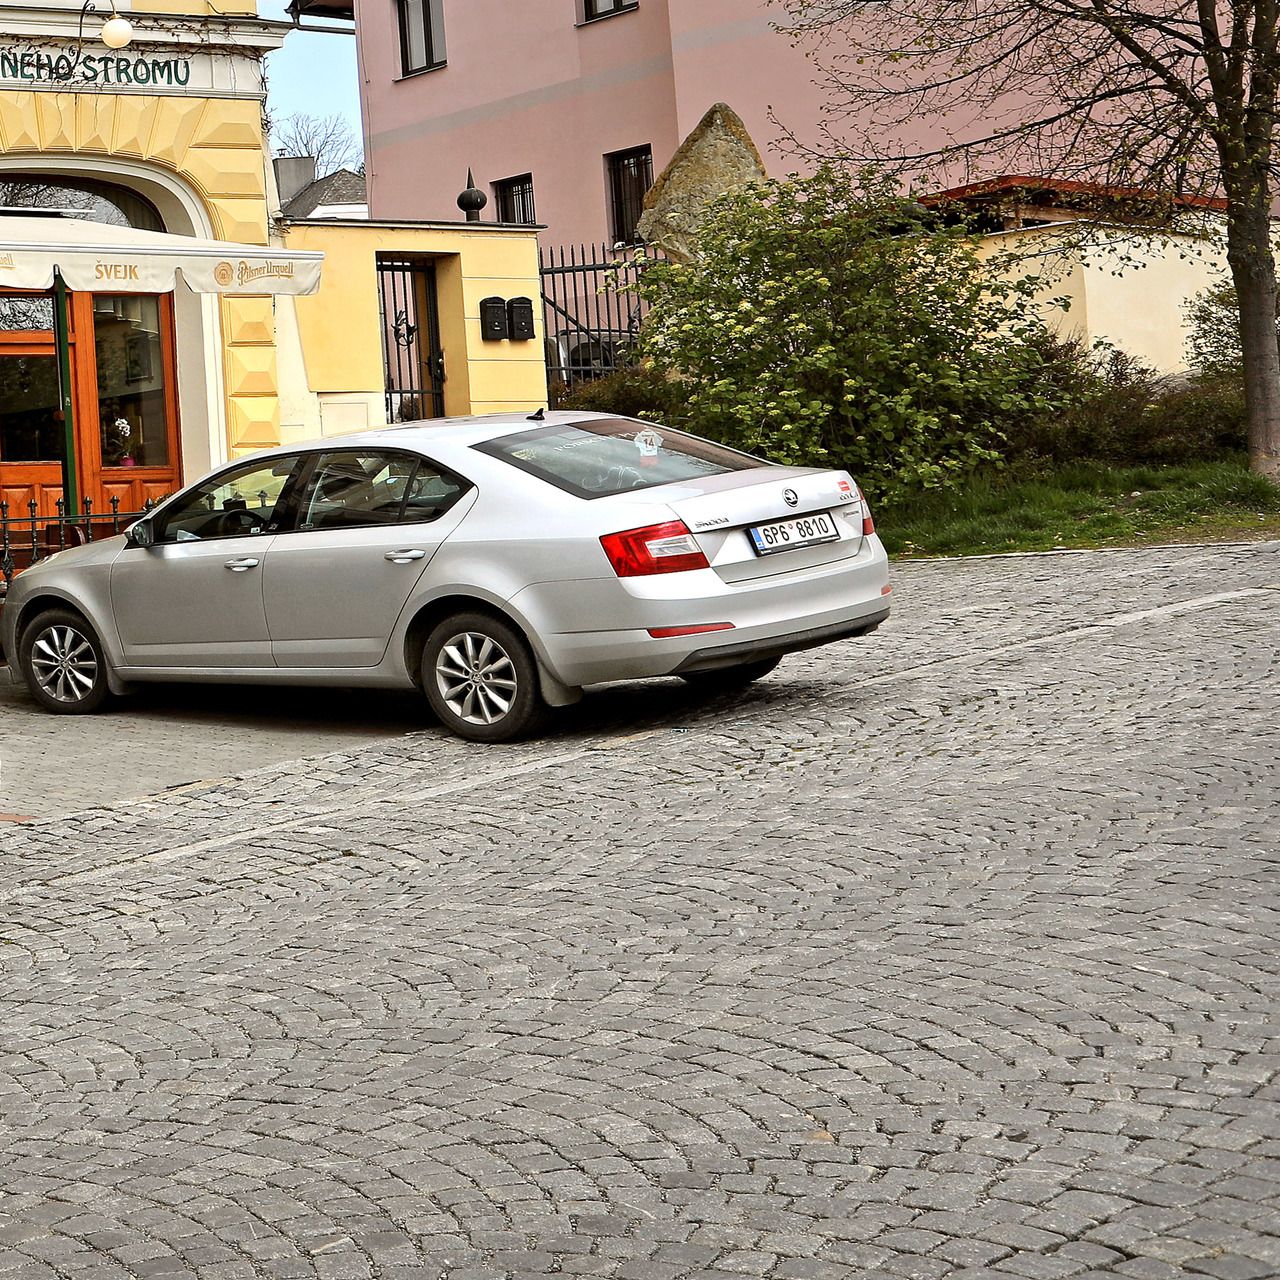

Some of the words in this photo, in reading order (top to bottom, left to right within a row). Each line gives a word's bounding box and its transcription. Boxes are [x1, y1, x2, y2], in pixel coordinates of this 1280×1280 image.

[79, 55, 191, 86] STROMU
[95, 260, 139, 281] ŠVEJK
[237, 260, 267, 286] Pilsner
[265, 260, 295, 280] Urquell
[762, 524, 790, 545] 6P6
[796, 517, 829, 538] 8810
